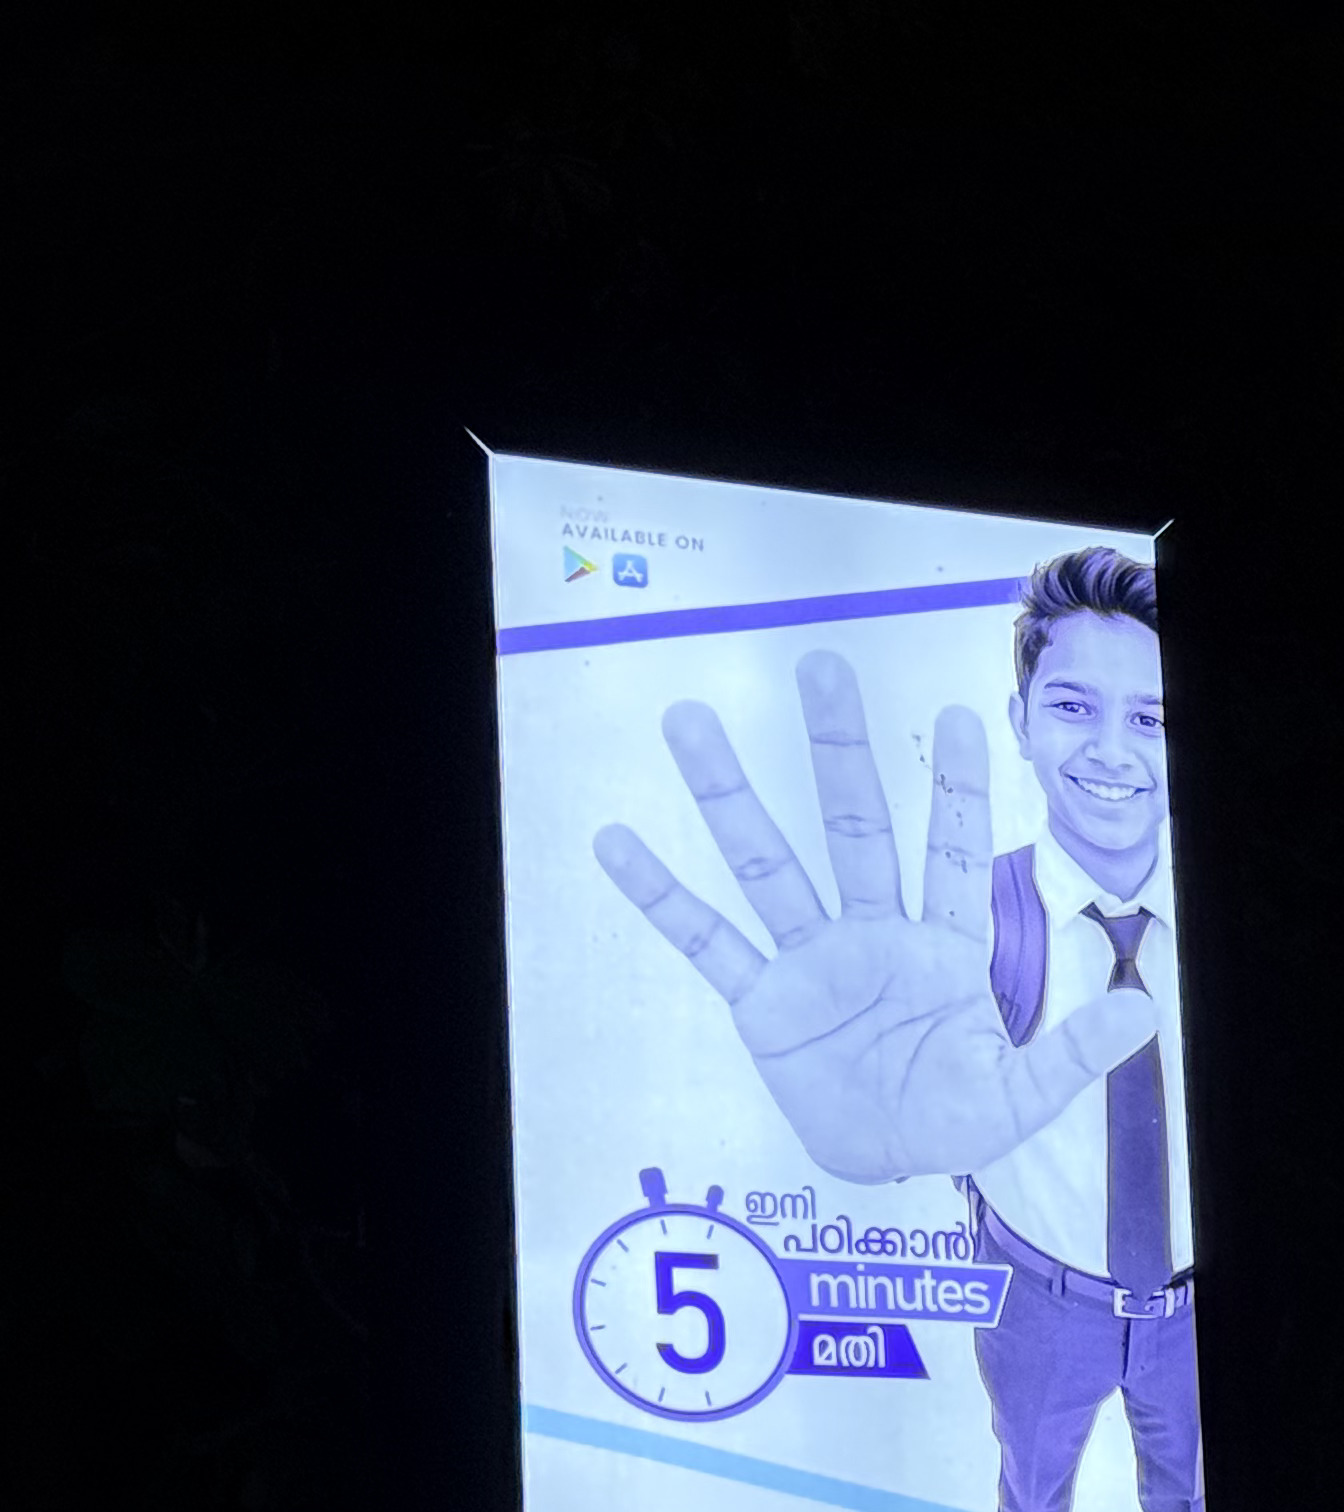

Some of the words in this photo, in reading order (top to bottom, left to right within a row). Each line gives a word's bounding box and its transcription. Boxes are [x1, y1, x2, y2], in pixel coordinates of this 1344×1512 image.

[562, 522, 667, 547] AVAILABLE
[675, 535, 705, 552] ON
[745, 1185, 817, 1226] ഇനി
[810, 1265, 991, 1314] minutes
[654, 1251, 726, 1375] 5
[811, 1325, 886, 1368] മതി
